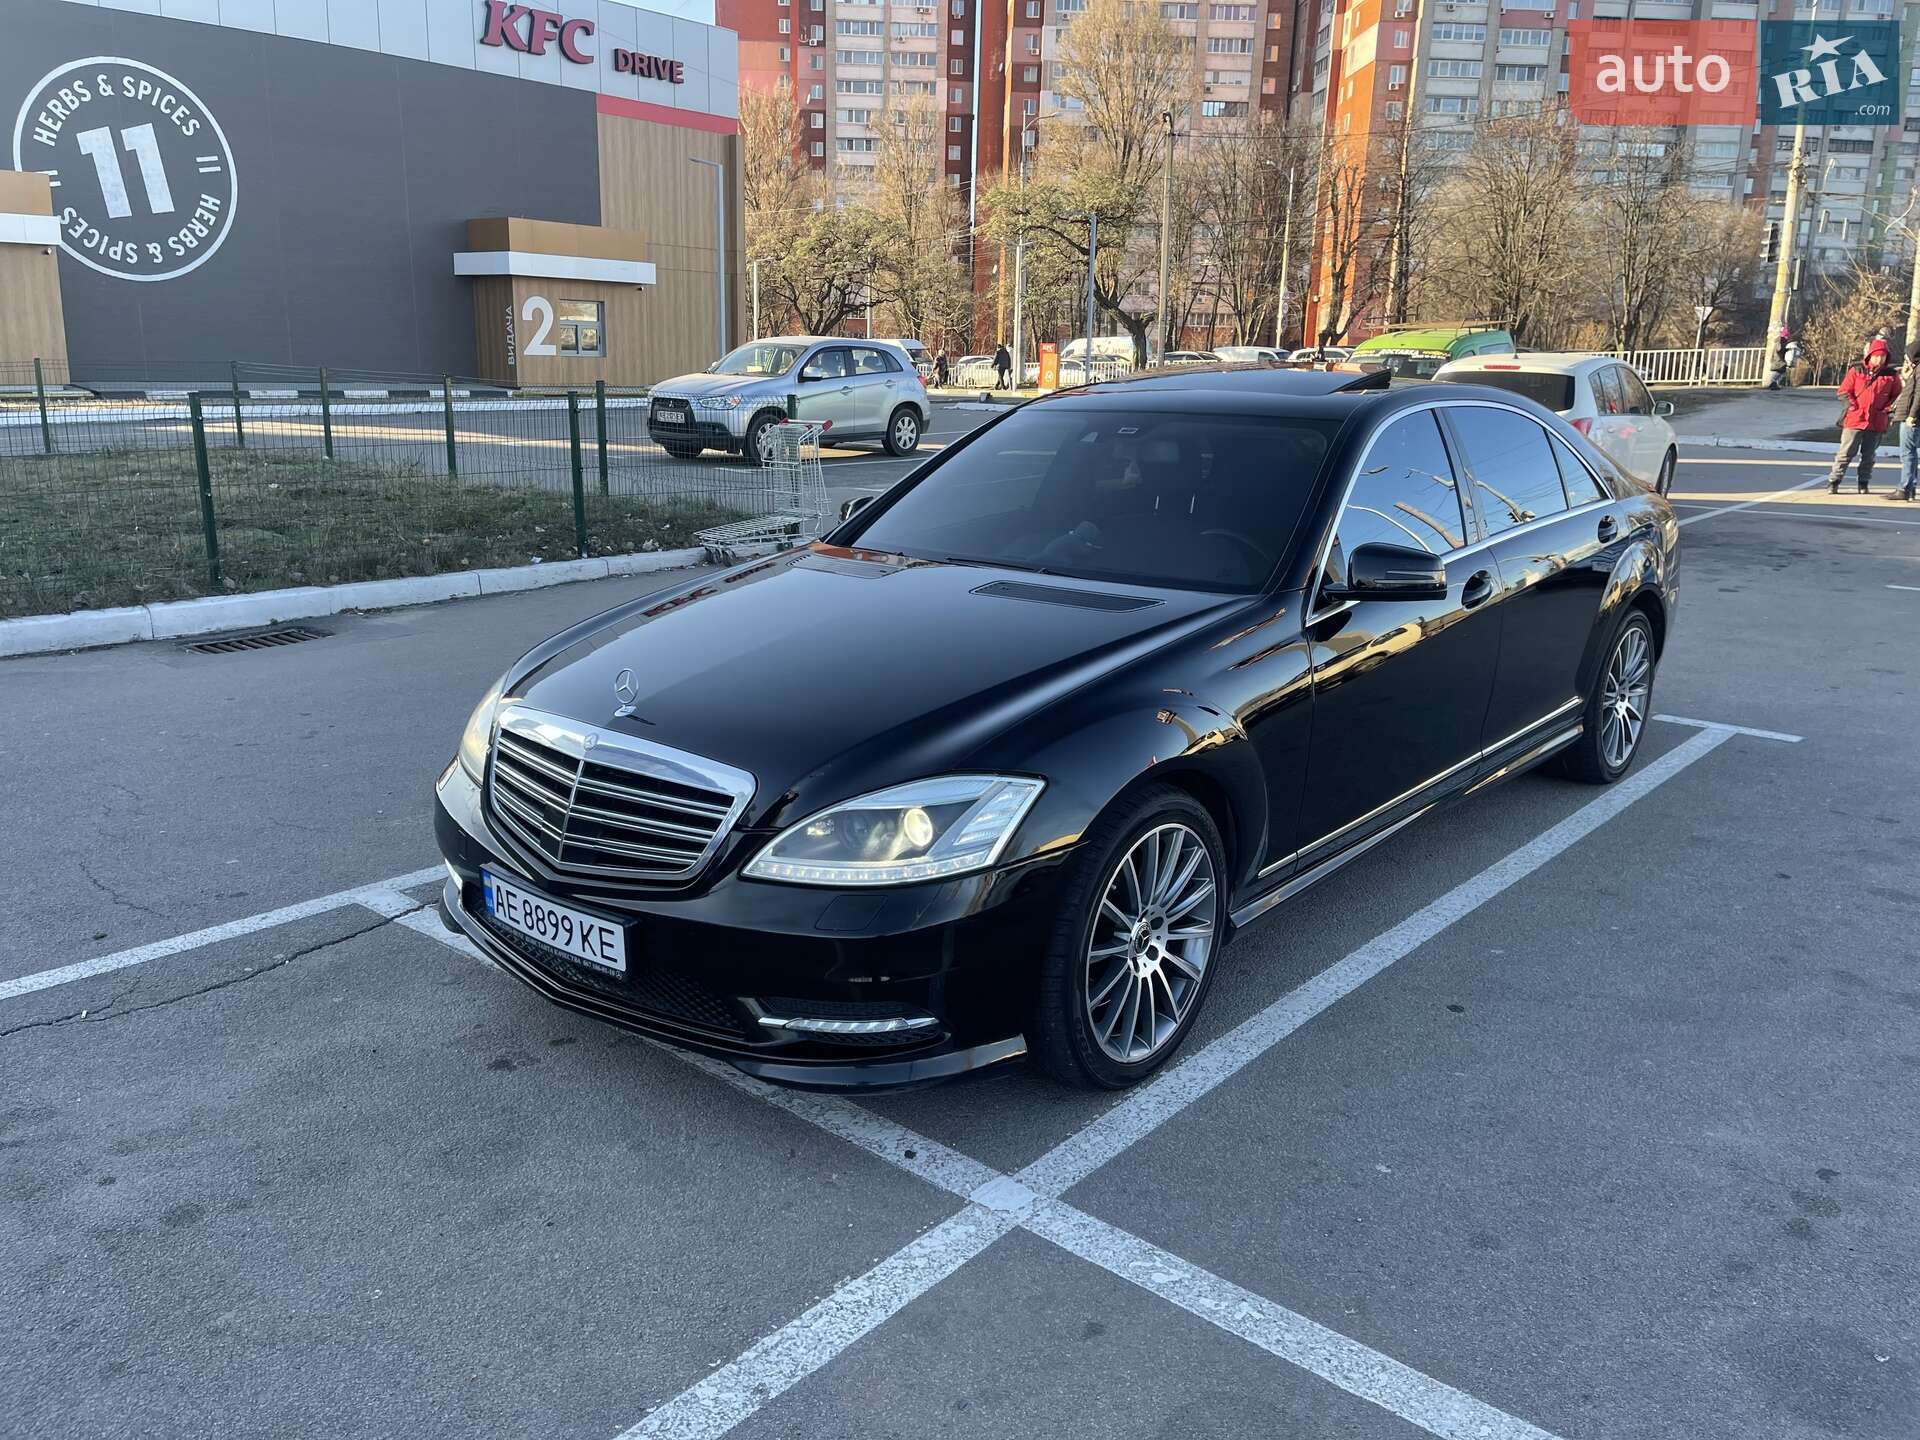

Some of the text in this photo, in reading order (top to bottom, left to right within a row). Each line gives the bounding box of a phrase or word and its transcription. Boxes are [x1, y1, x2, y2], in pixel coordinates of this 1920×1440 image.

[480, 0, 595, 64] KFC
[614, 48, 684, 84] DRIVE
[33, 74, 200, 147] HERBS & SPICES
[76, 123, 175, 219] 11
[60, 193, 221, 264] HERBS & SPICES
[505, 305, 515, 365] ВИДАЧА
[522, 295, 557, 356] 2
[496, 884, 521, 925] AE
[523, 899, 574, 947] 8899
[579, 920, 618, 963] KE
